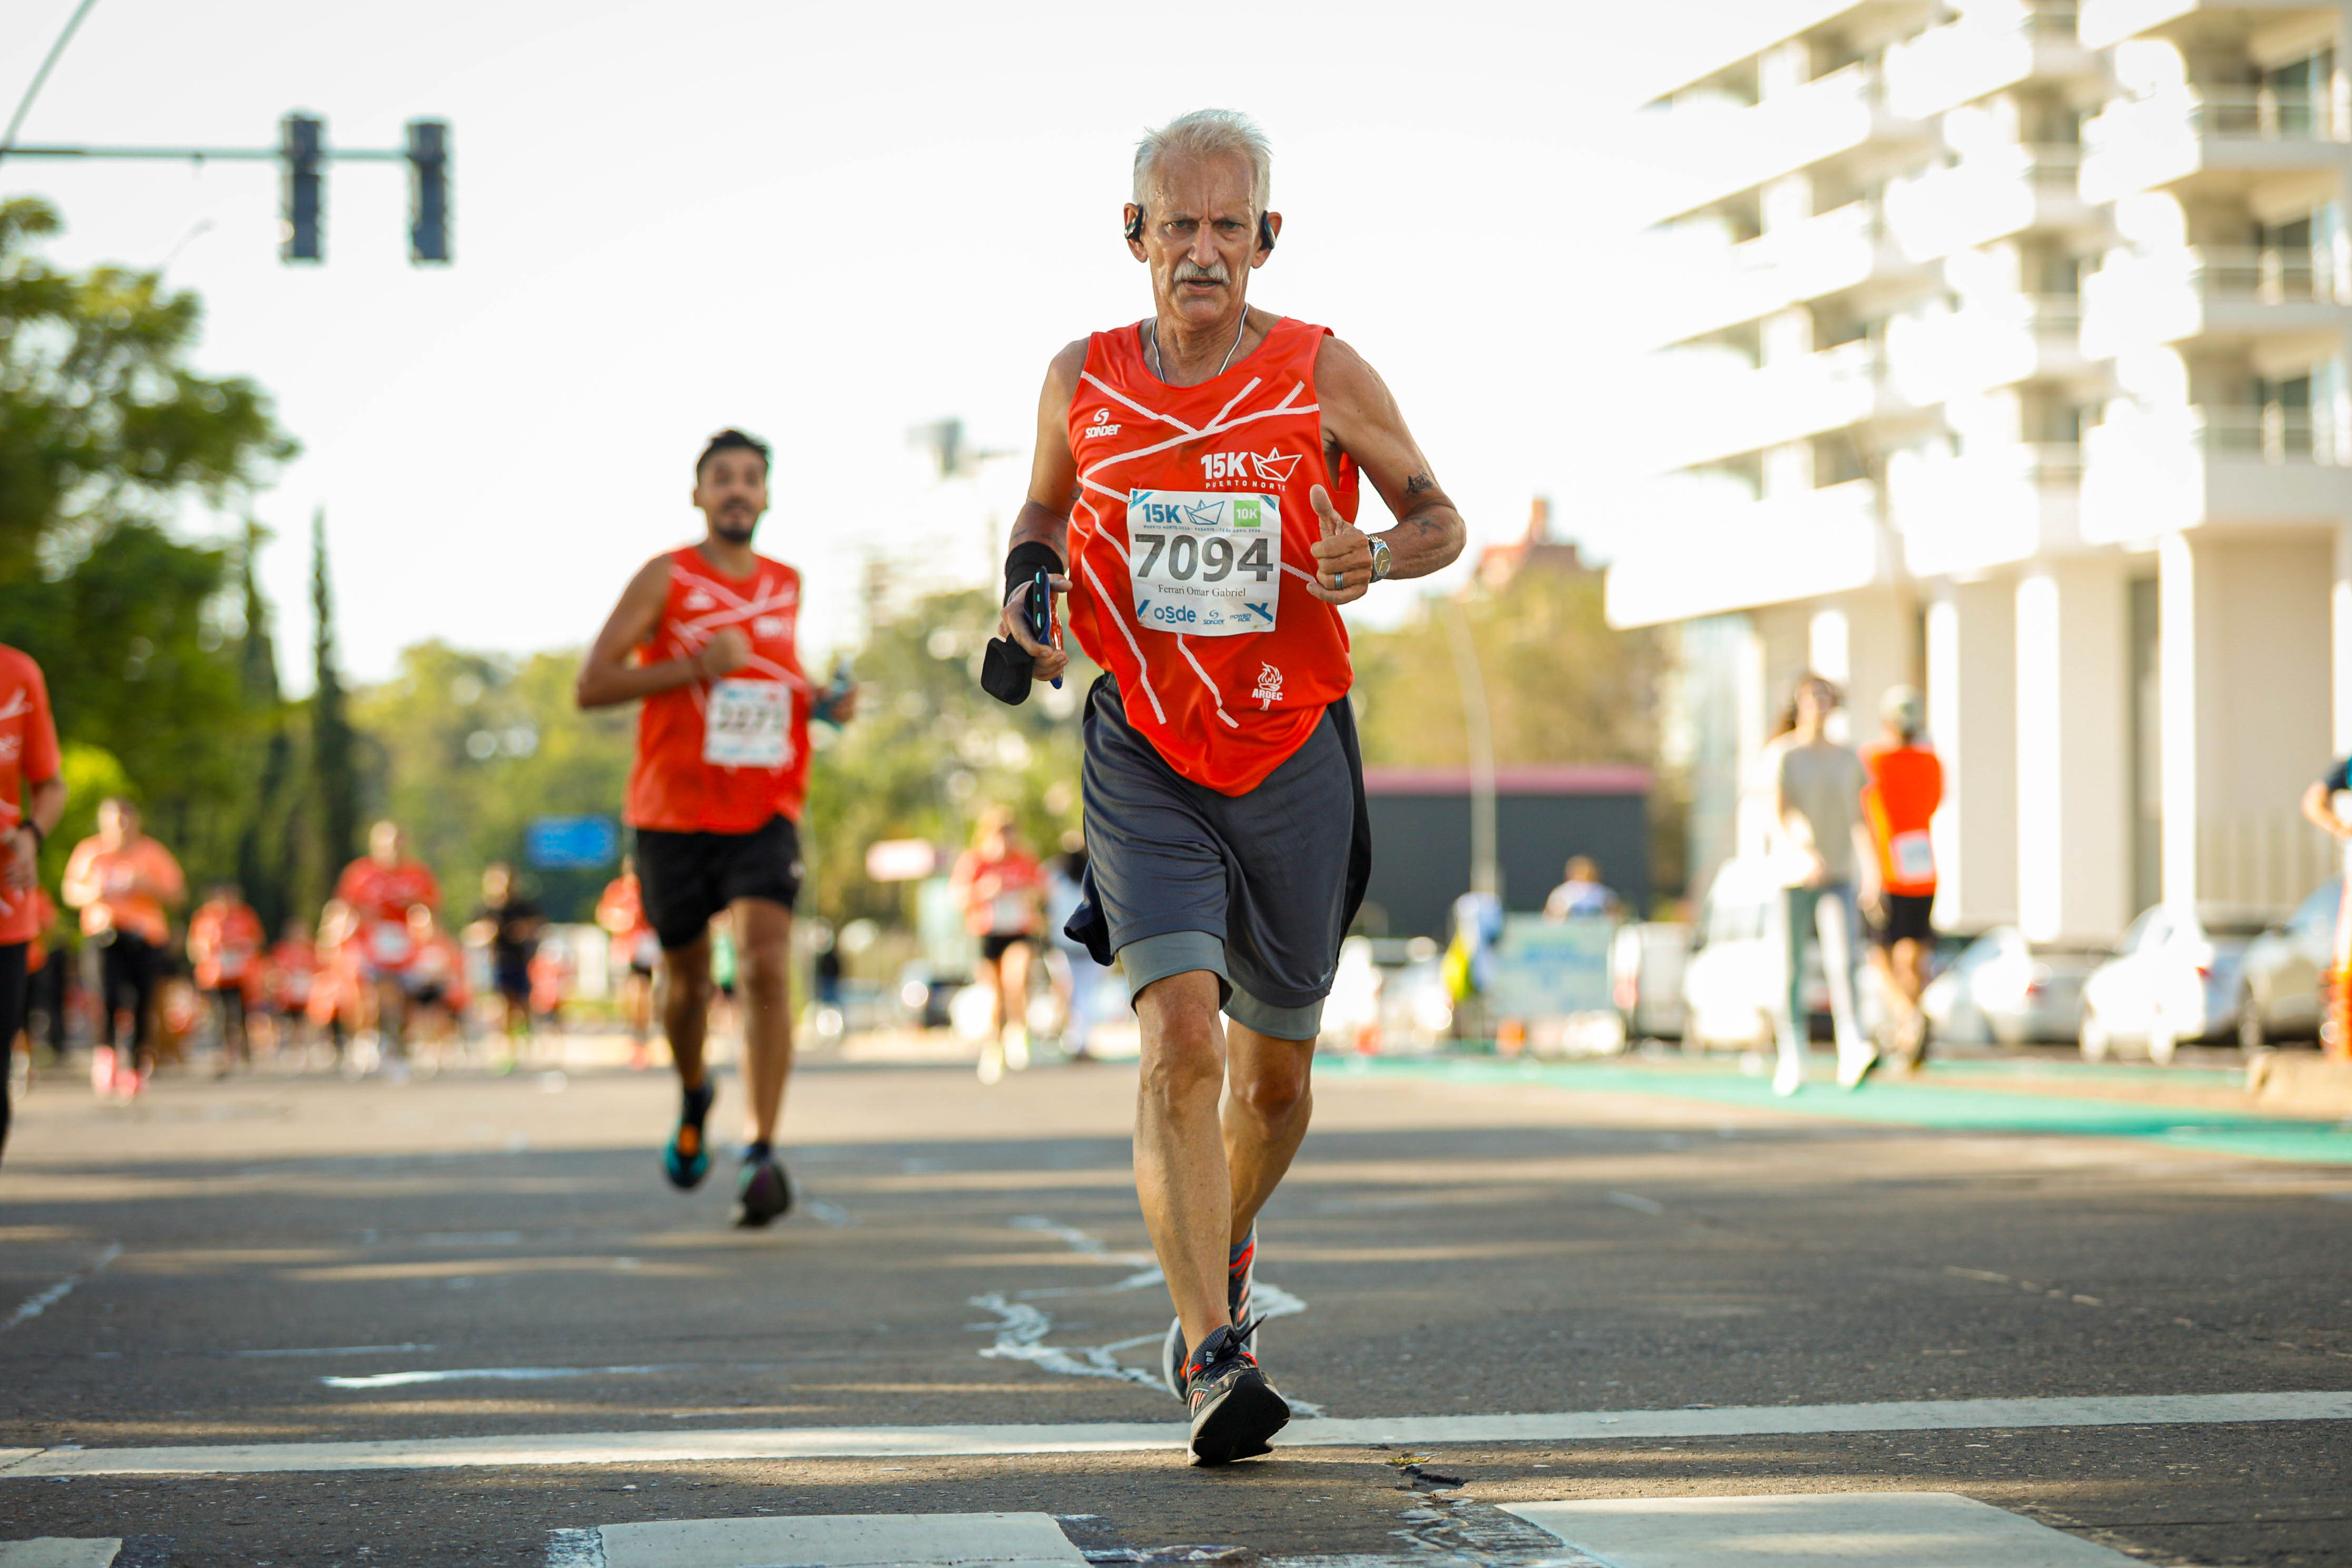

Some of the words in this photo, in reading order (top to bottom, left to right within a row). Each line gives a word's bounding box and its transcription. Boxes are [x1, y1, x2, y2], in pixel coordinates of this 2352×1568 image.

[1201, 452, 1249, 480] 15K
[1206, 480, 1248, 489] PUERTO
[1252, 481, 1286, 492] NORTE
[1142, 503, 1182, 524] 15K
[1236, 508, 1258, 520] 10K
[1134, 533, 1273, 582] 7094
[1159, 584, 1184, 594] Ferrari
[1187, 586, 1210, 596] Omar
[1212, 587, 1246, 596] Gabriel
[1154, 605, 1197, 623] osde
[1251, 688, 1283, 701] ARDEC
